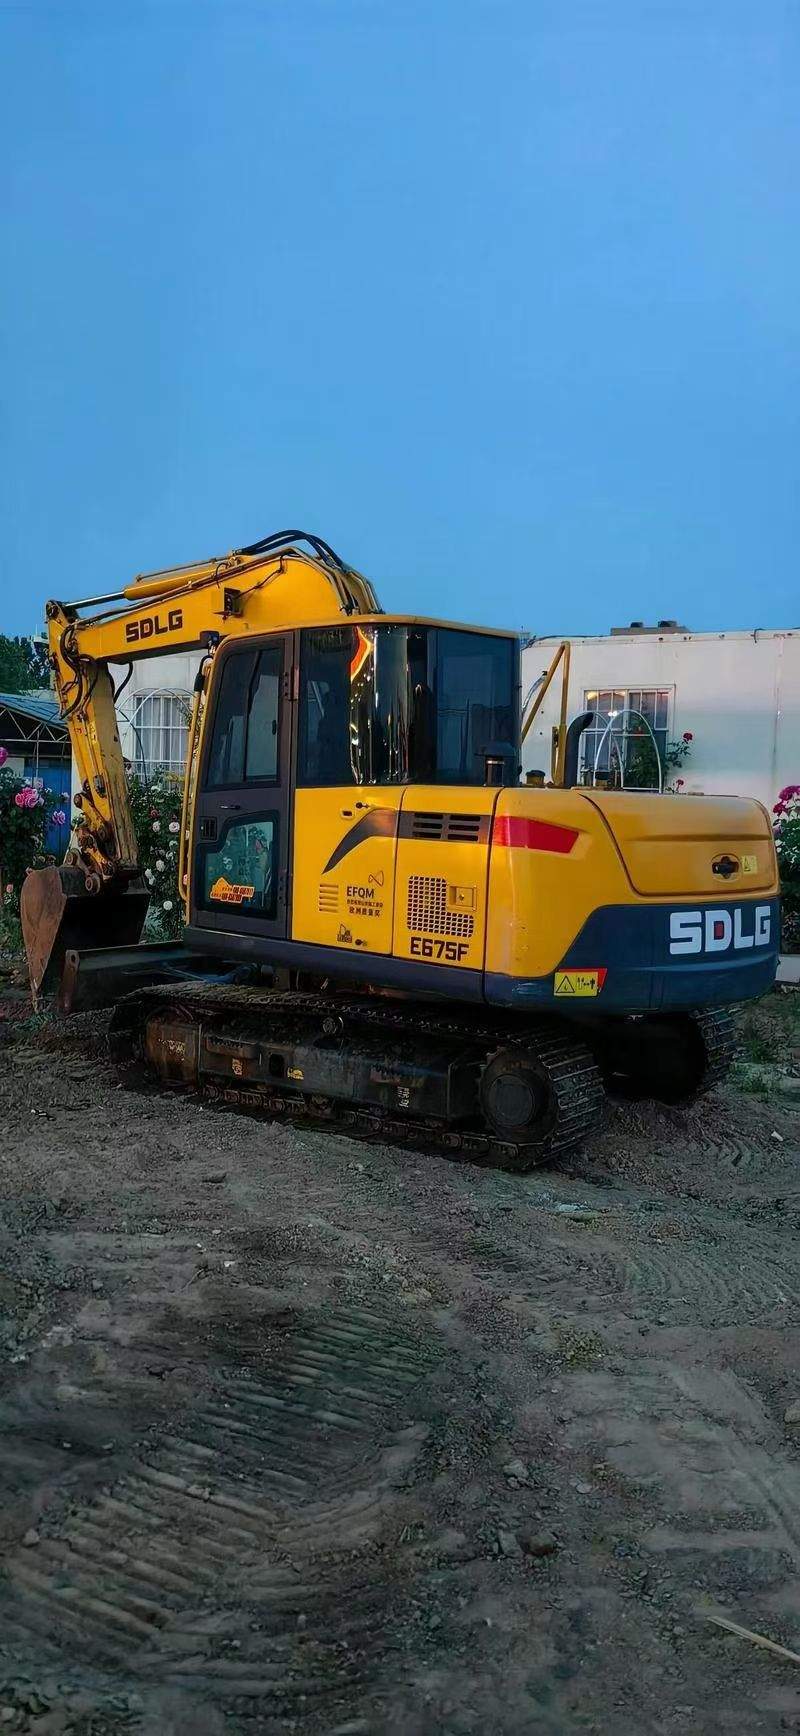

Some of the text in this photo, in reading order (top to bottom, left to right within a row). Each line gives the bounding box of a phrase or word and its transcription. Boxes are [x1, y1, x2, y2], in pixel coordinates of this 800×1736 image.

[126, 609, 183, 643] SDLG
[347, 886, 375, 898] EFQM
[669, 905, 771, 955] SDLG
[410, 936, 469, 961] E675F
